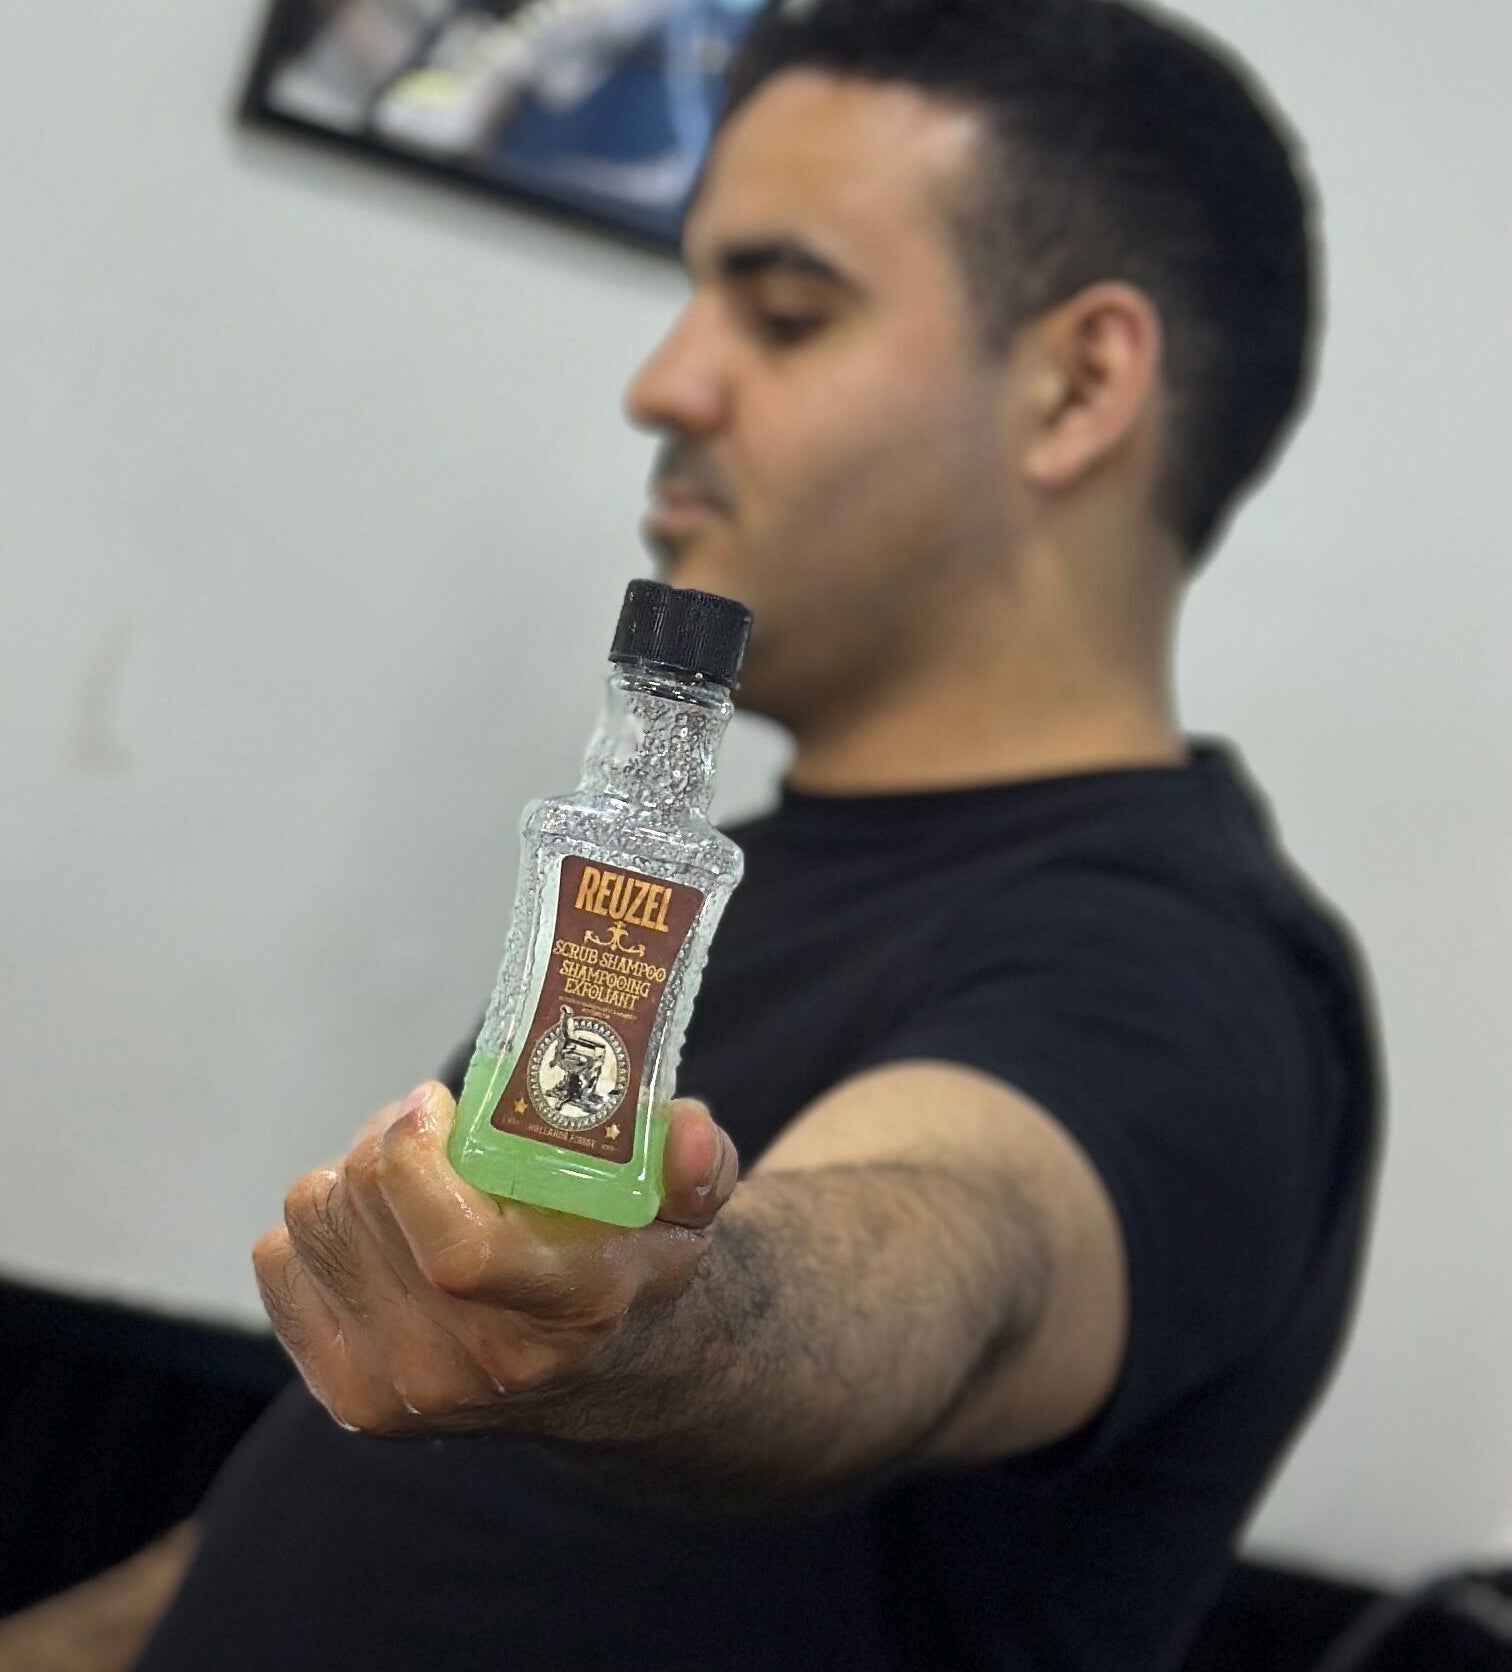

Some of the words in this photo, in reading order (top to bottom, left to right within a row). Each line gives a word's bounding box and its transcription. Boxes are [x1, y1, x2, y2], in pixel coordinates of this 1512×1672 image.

[575, 866, 672, 932] REUZEL
[553, 939, 598, 964] SCRUB
[599, 952, 666, 983] SHAMPOO
[559, 960, 651, 998] SHAMPOOING
[564, 978, 639, 1011] EXFOLIANT
